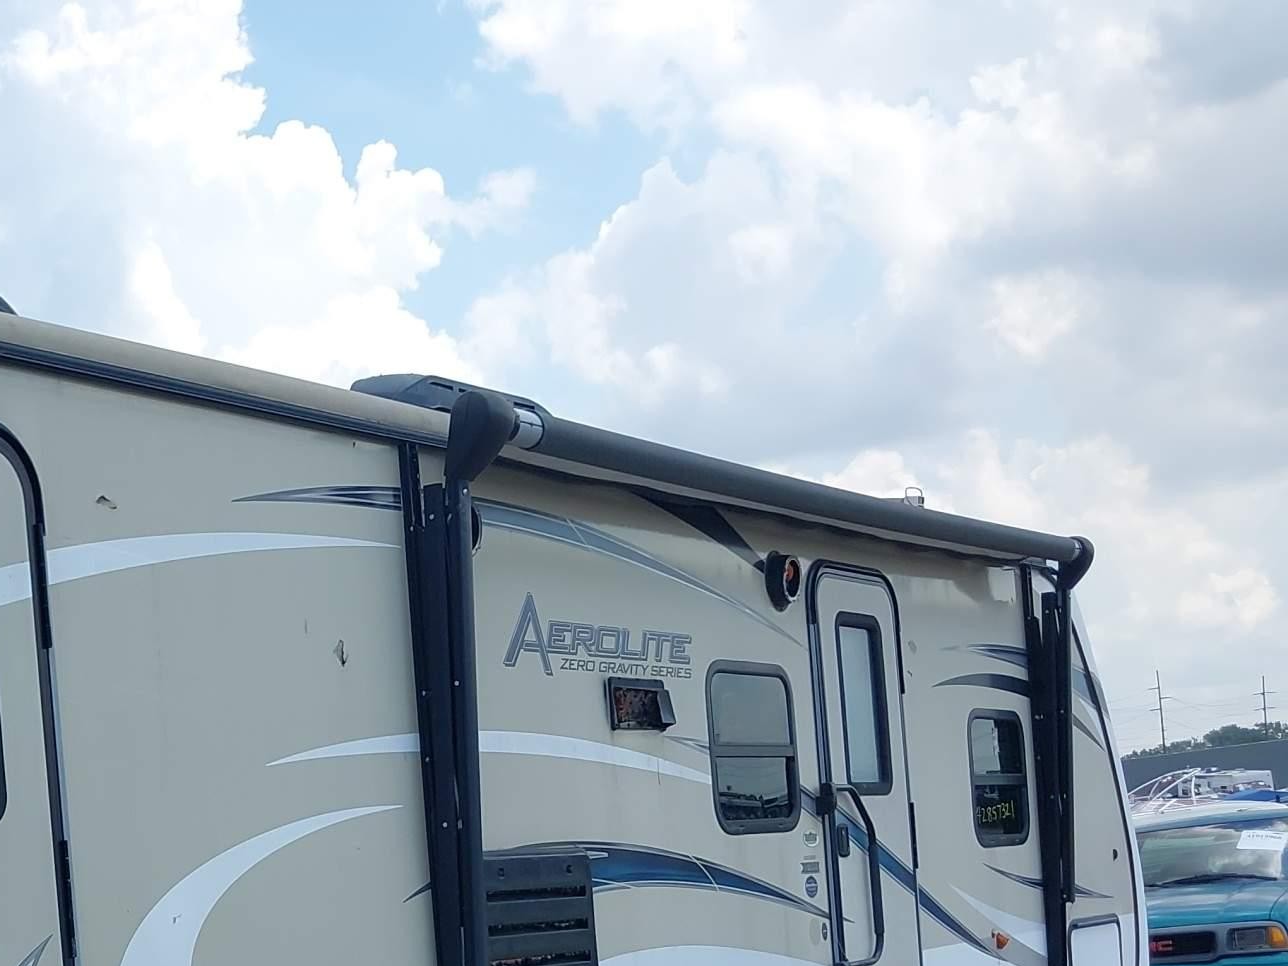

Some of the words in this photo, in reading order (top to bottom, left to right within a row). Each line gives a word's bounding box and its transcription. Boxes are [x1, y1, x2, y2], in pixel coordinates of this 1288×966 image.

[503, 591, 692, 677] AEROLITE
[559, 658, 595, 673] ZERO
[598, 662, 649, 676] GRAVITY
[650, 665, 692, 679] SERIES
[976, 800, 1015, 824] 42857321
